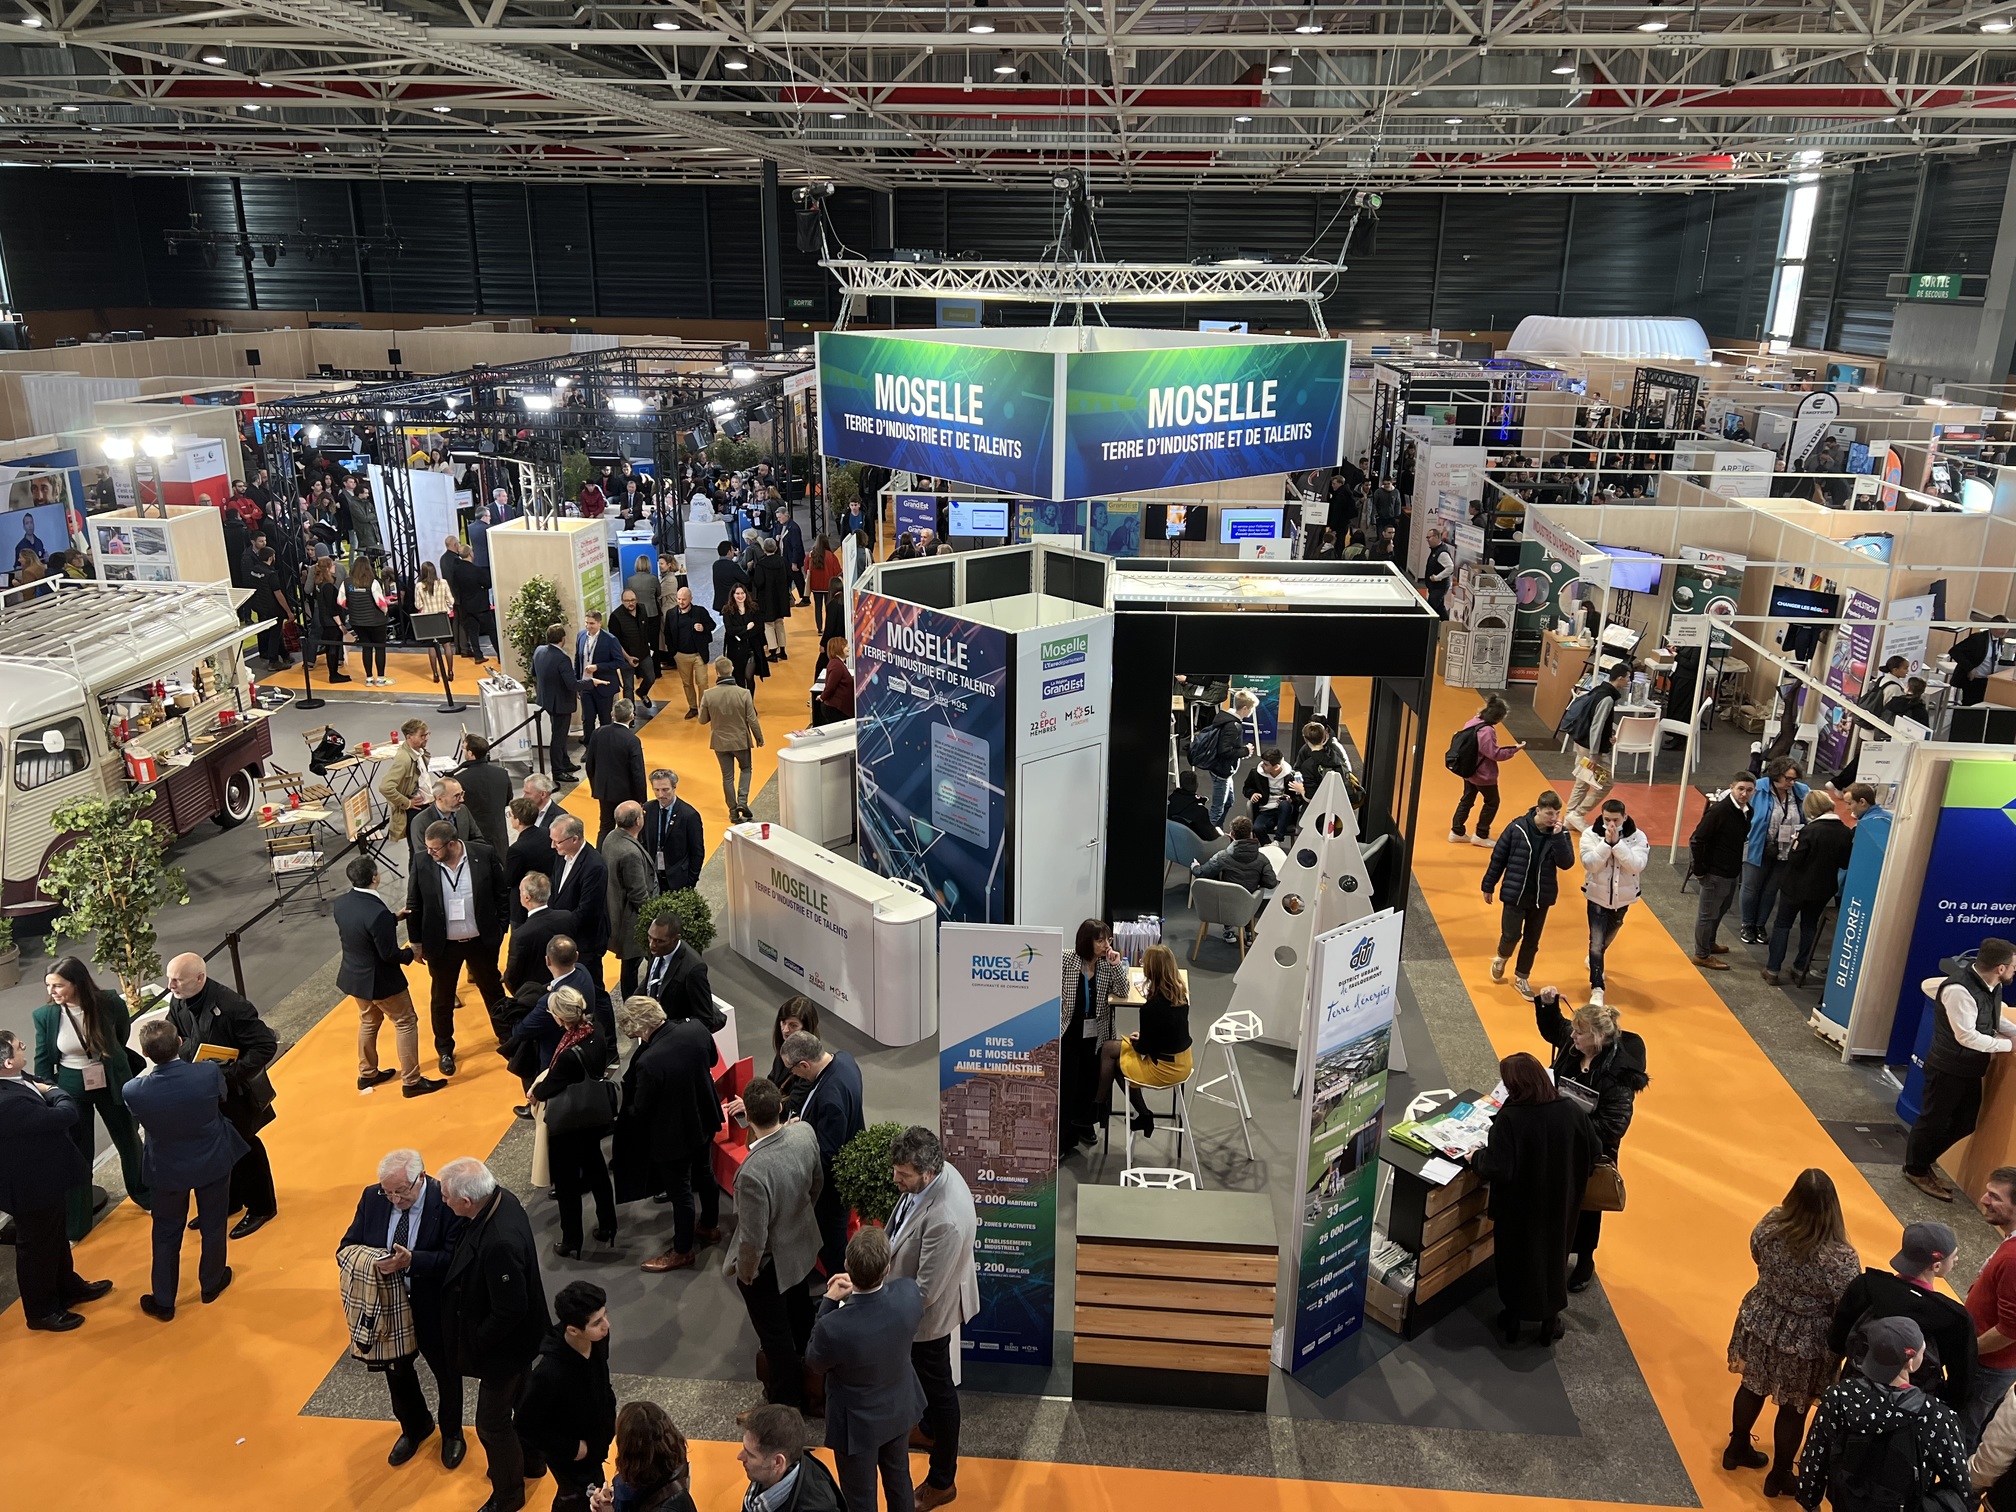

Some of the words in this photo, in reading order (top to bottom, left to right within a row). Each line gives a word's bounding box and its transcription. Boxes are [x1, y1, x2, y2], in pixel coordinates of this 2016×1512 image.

[1920, 275, 1950, 288] SORTIE
[874, 373, 984, 426] MOSELLE
[1148, 380, 1278, 429] MOSELLE
[844, 414, 874, 434] TERRE
[876, 418, 938, 445] D'INDUSTRIE
[940, 430, 952, 447] ET
[956, 432, 970, 451] DE
[973, 434, 1022, 459] TALENTS
[1102, 439, 1144, 461] TERRE
[1147, 431, 1225, 457] D'INDUSTRIE
[1227, 429, 1243, 447] ET
[1245, 427, 1261, 446] DE
[1263, 422, 1312, 444] TALENTS
[904, 500, 919, 508] Grand
[920, 502, 929, 510] Est
[1559, 538, 1576, 560] PAPIER
[1853, 599, 1877, 614] AHLSTROM
[887, 621, 968, 670] MOSELLE
[1042, 638, 1086, 659] Moselle
[863, 644, 886, 662] TERRE
[887, 653, 934, 678] D'INDUSTRIE
[936, 668, 946, 681] ET
[947, 671, 958, 685] DE
[959, 675, 996, 697] TALENTS
[1044, 682, 1069, 695] Grand
[1070, 678, 1083, 689] Est
[1065, 705, 1095, 721] MOSL
[1030, 722, 1039, 731] 22
[1040, 717, 1056, 728] EPCI
[1030, 725, 1057, 737] MEMBRES
[770, 867, 828, 915] MOSELLE
[754, 880, 771, 897] TERRE
[772, 890, 805, 916] D'INDUSTRIE
[806, 909, 814, 920] ET
[814, 913, 822, 925] DE
[823, 918, 848, 939] TALENTS
[1938, 900, 1957, 909] On
[1945, 913, 1954, 922] à
[1958, 914, 2015, 926] fabriquer
[1836, 896, 1862, 988] BLEUFORÊT
[1350, 937, 1374, 969] duf
[972, 955, 1011, 968] RIVES
[1013, 961, 1024, 970] DE
[972, 968, 1029, 982] MOSELLE
[1339, 974, 1359, 987] DISTRICT
[1361, 966, 1379, 977] URBAIN
[1349, 971, 1382, 989] FAULQUEMONT
[1327, 1000, 1350, 1022] Terre
[1354, 985, 1390, 1009] d'énergies
[985, 1037, 1014, 1047] RIVES
[969, 1049, 982, 1058] DE
[985, 1050, 1030, 1060] MOSELLE
[957, 1061, 981, 1071] AIME
[984, 1062, 1042, 1073] L'INDUSTRIE
[977, 1169, 995, 1181] 20
[985, 1195, 1006, 1205] 000
[1327, 1203, 1338, 1218] 33
[1319, 1232, 1328, 1245] 25
[1330, 1223, 1344, 1238] 000
[984, 1238, 1032, 1246] ÉTABLISSEMENTS
[984, 1263, 1005, 1272] 200
[1320, 1256, 1325, 1265] 6
[1320, 1271, 1333, 1286] 160
[1317, 1298, 1323, 1308] 5
[1324, 1289, 1338, 1304] 300
